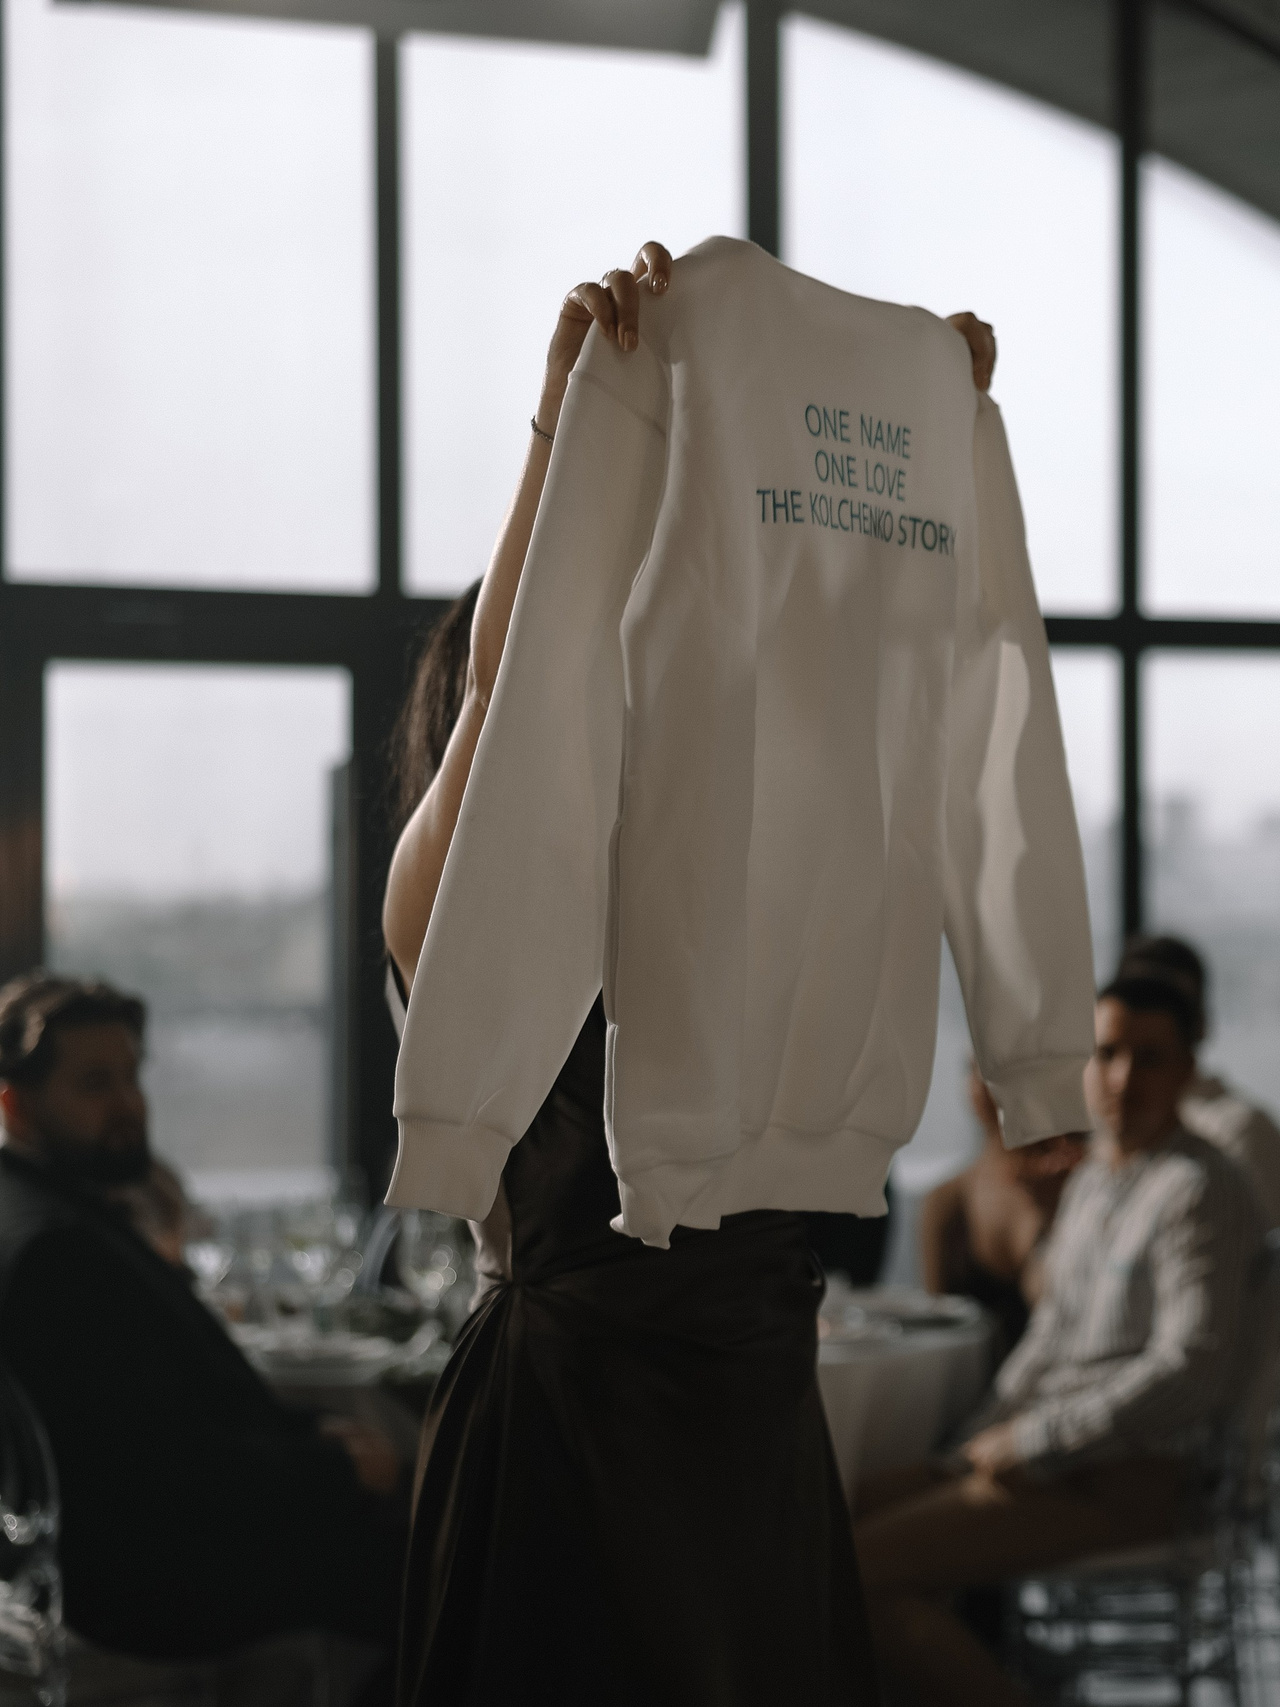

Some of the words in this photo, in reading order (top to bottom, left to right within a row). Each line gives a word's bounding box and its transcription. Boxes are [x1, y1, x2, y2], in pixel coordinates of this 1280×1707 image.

[805, 404, 850, 442] ONE
[860, 413, 911, 459] NAME
[815, 450, 858, 488] ONE
[865, 459, 905, 502] LOVE
[756, 489, 804, 523] THE
[809, 491, 893, 543] KOLCHENKO
